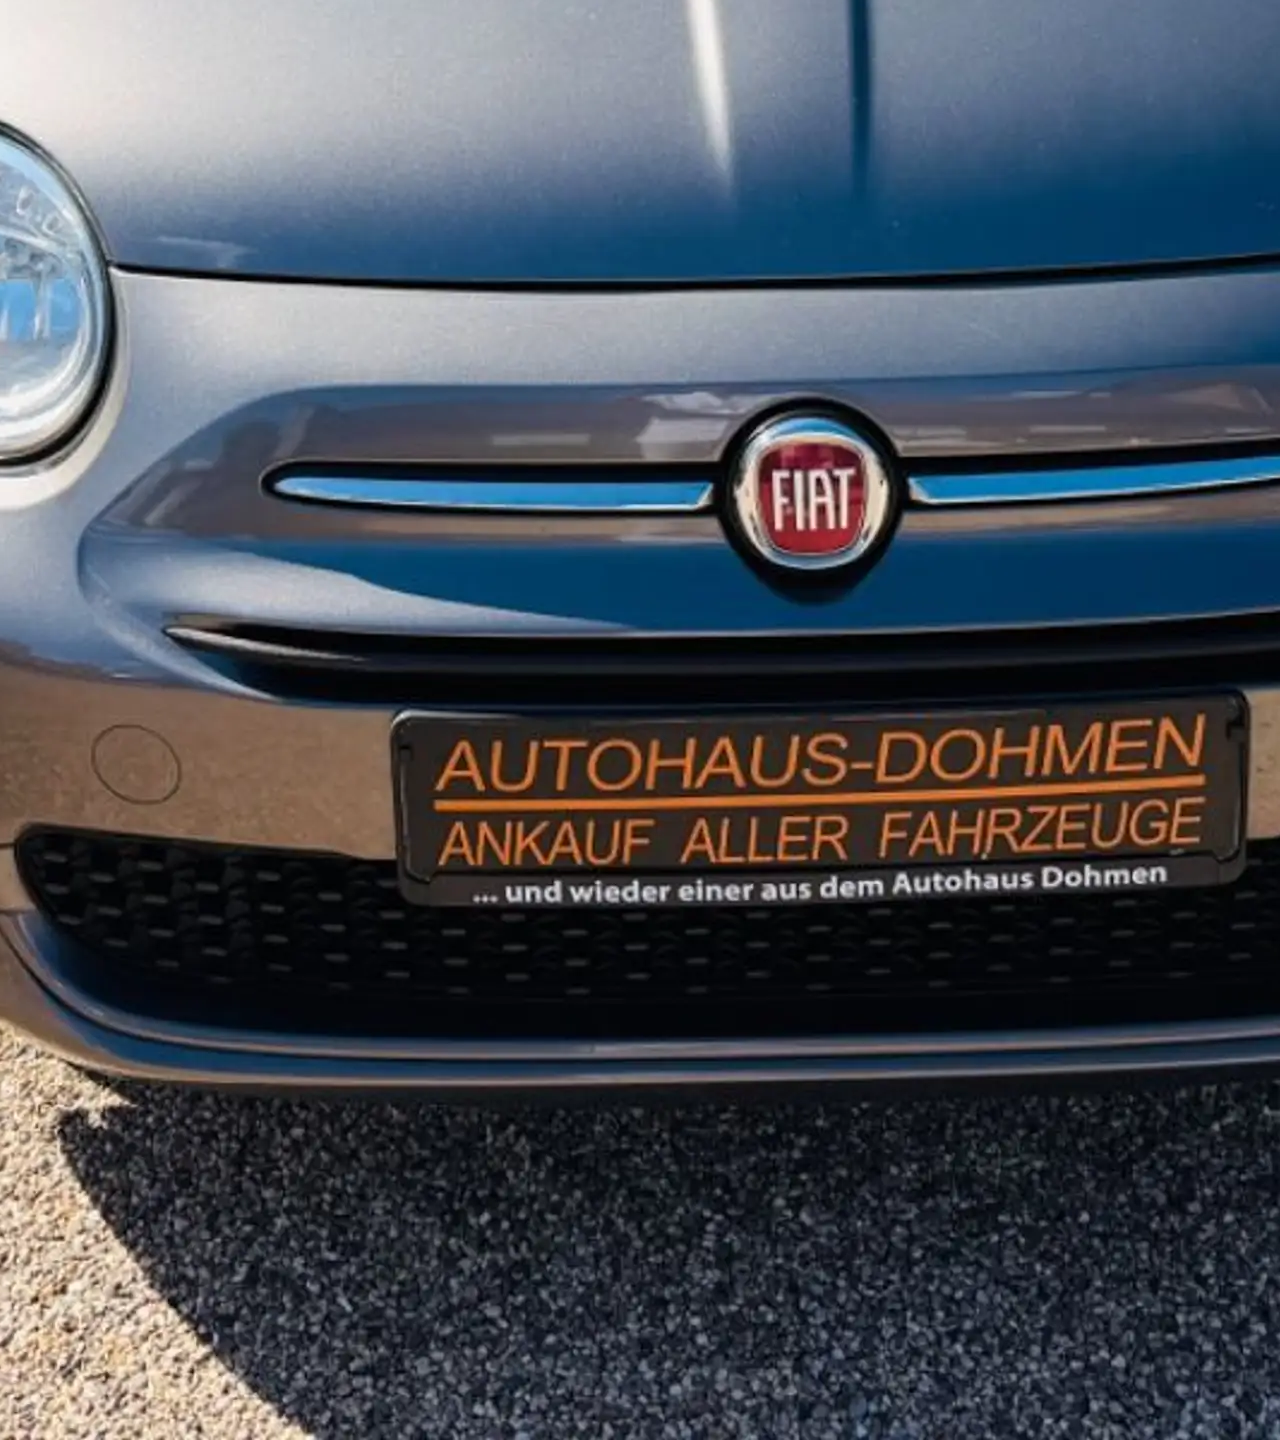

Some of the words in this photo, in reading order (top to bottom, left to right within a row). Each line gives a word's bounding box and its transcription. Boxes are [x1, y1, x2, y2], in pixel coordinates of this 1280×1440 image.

[772, 468, 857, 532] FIAT
[434, 713, 1206, 793] AUTOHAUS-DOHMEN
[437, 818, 655, 866] ANKAUF
[680, 815, 850, 865] ALLER
[878, 796, 1207, 859] FAHRZEUGE
[505, 879, 562, 904] und
[568, 878, 671, 904] wieder
[677, 877, 755, 902] einer
[760, 880, 813, 901] aus
[819, 873, 885, 899] dem
[891, 864, 1034, 896] Autohaus
[1040, 863, 1169, 890] Dohmen
